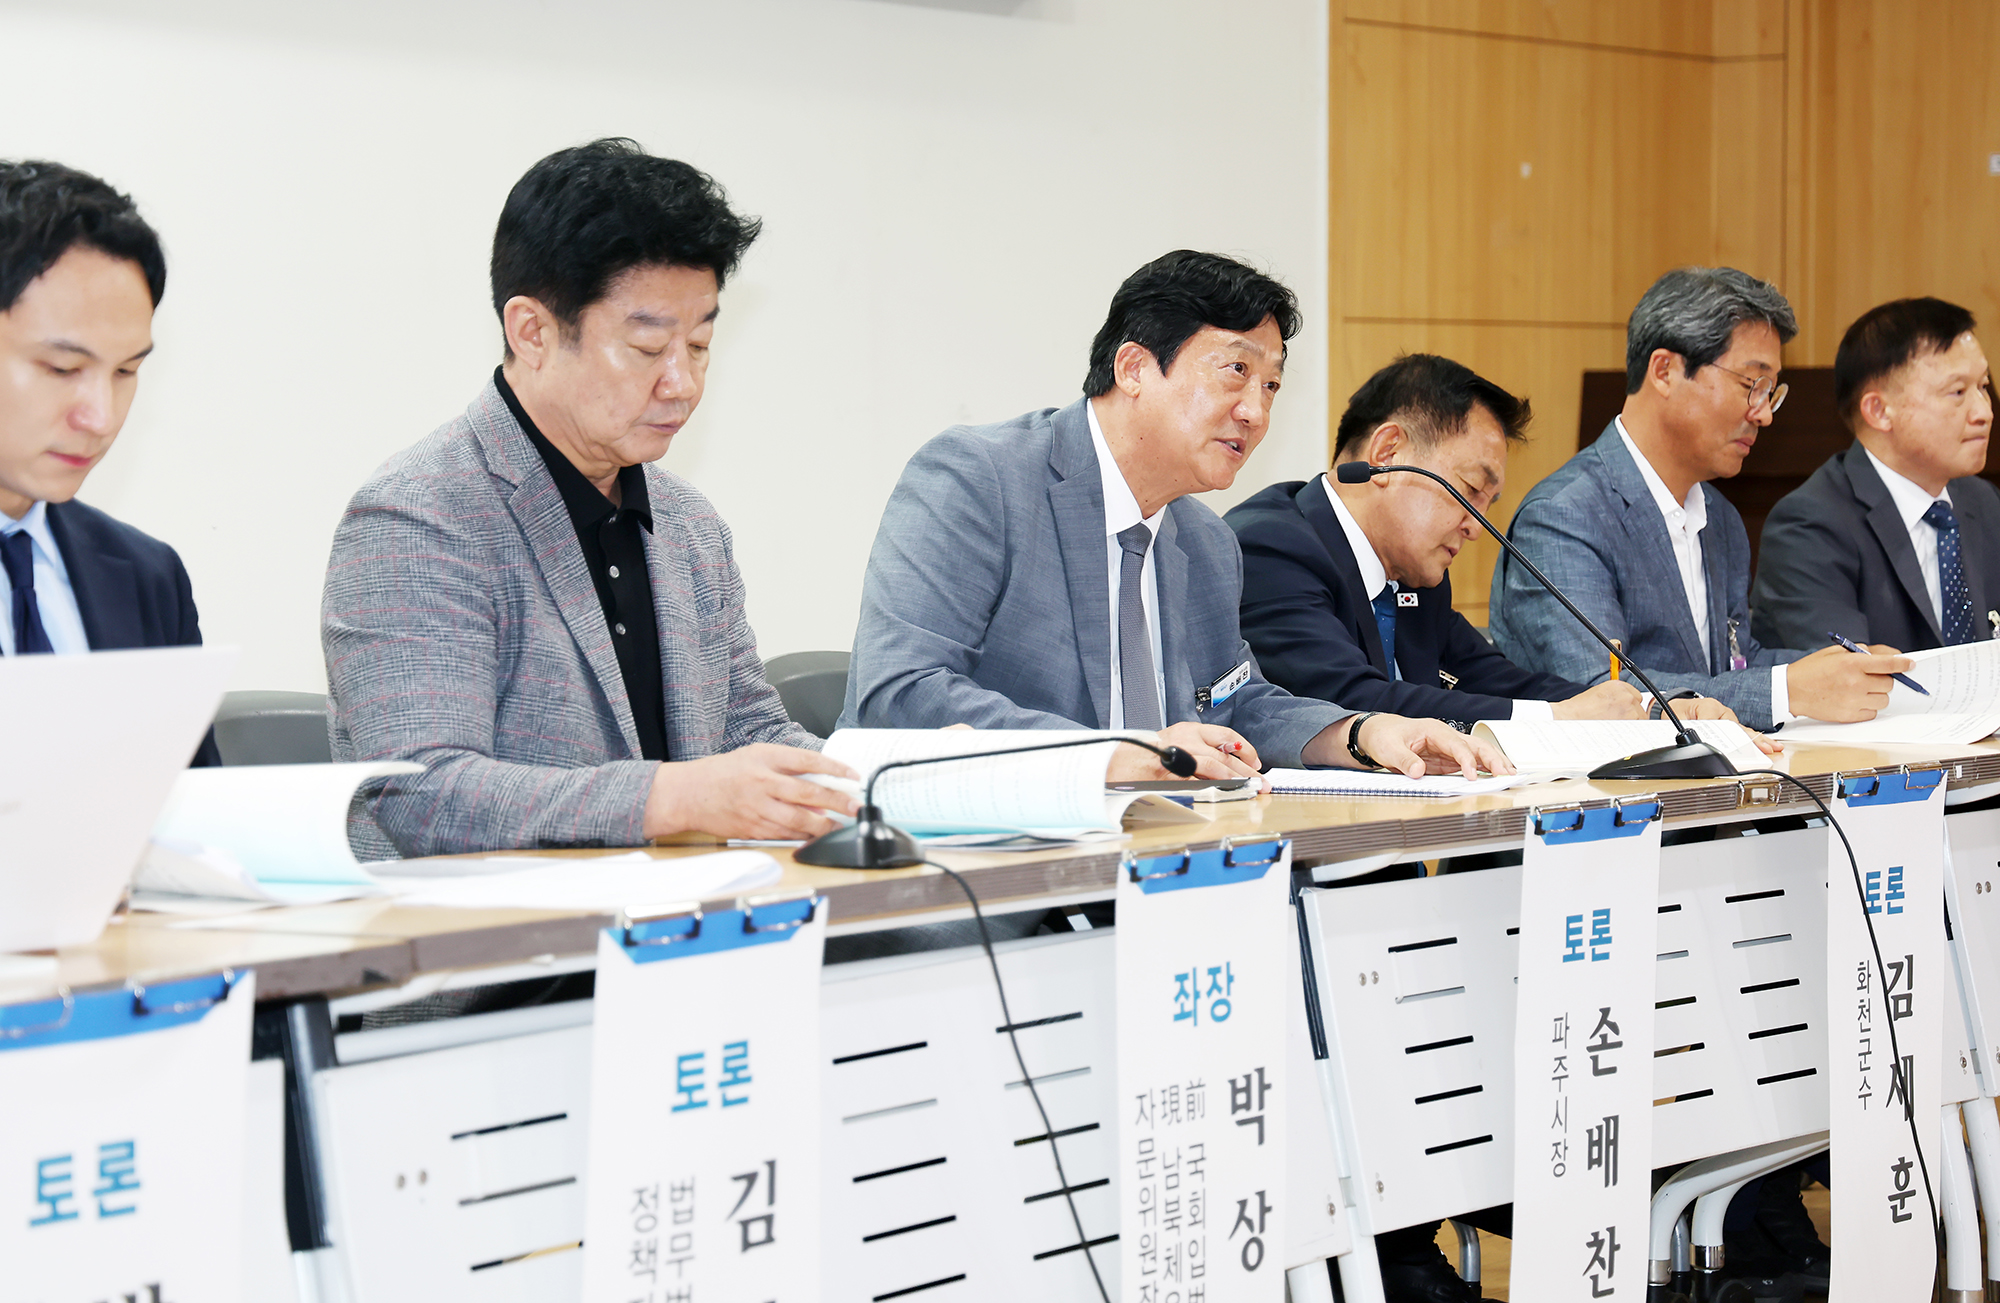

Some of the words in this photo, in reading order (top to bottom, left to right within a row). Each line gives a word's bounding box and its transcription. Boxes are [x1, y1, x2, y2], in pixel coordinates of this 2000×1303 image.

[1863, 865, 1906, 917] 토론
[1563, 908, 1613, 963] 토론
[1173, 961, 1235, 1027] 좌장
[1856, 959, 1873, 1111] 화천군수
[671, 1040, 753, 1113] 토론
[1160, 1084, 1182, 1127] 現
[1185, 1077, 1207, 1121] 前
[1551, 1012, 1570, 1178] 파주시장
[1885, 954, 1917, 1224] 김세훈
[28, 1140, 141, 1228] 토론
[1228, 1066, 1273, 1273] 박상
[1582, 1006, 1624, 1299] 손배찬
[627, 1182, 659, 1303] 정책
